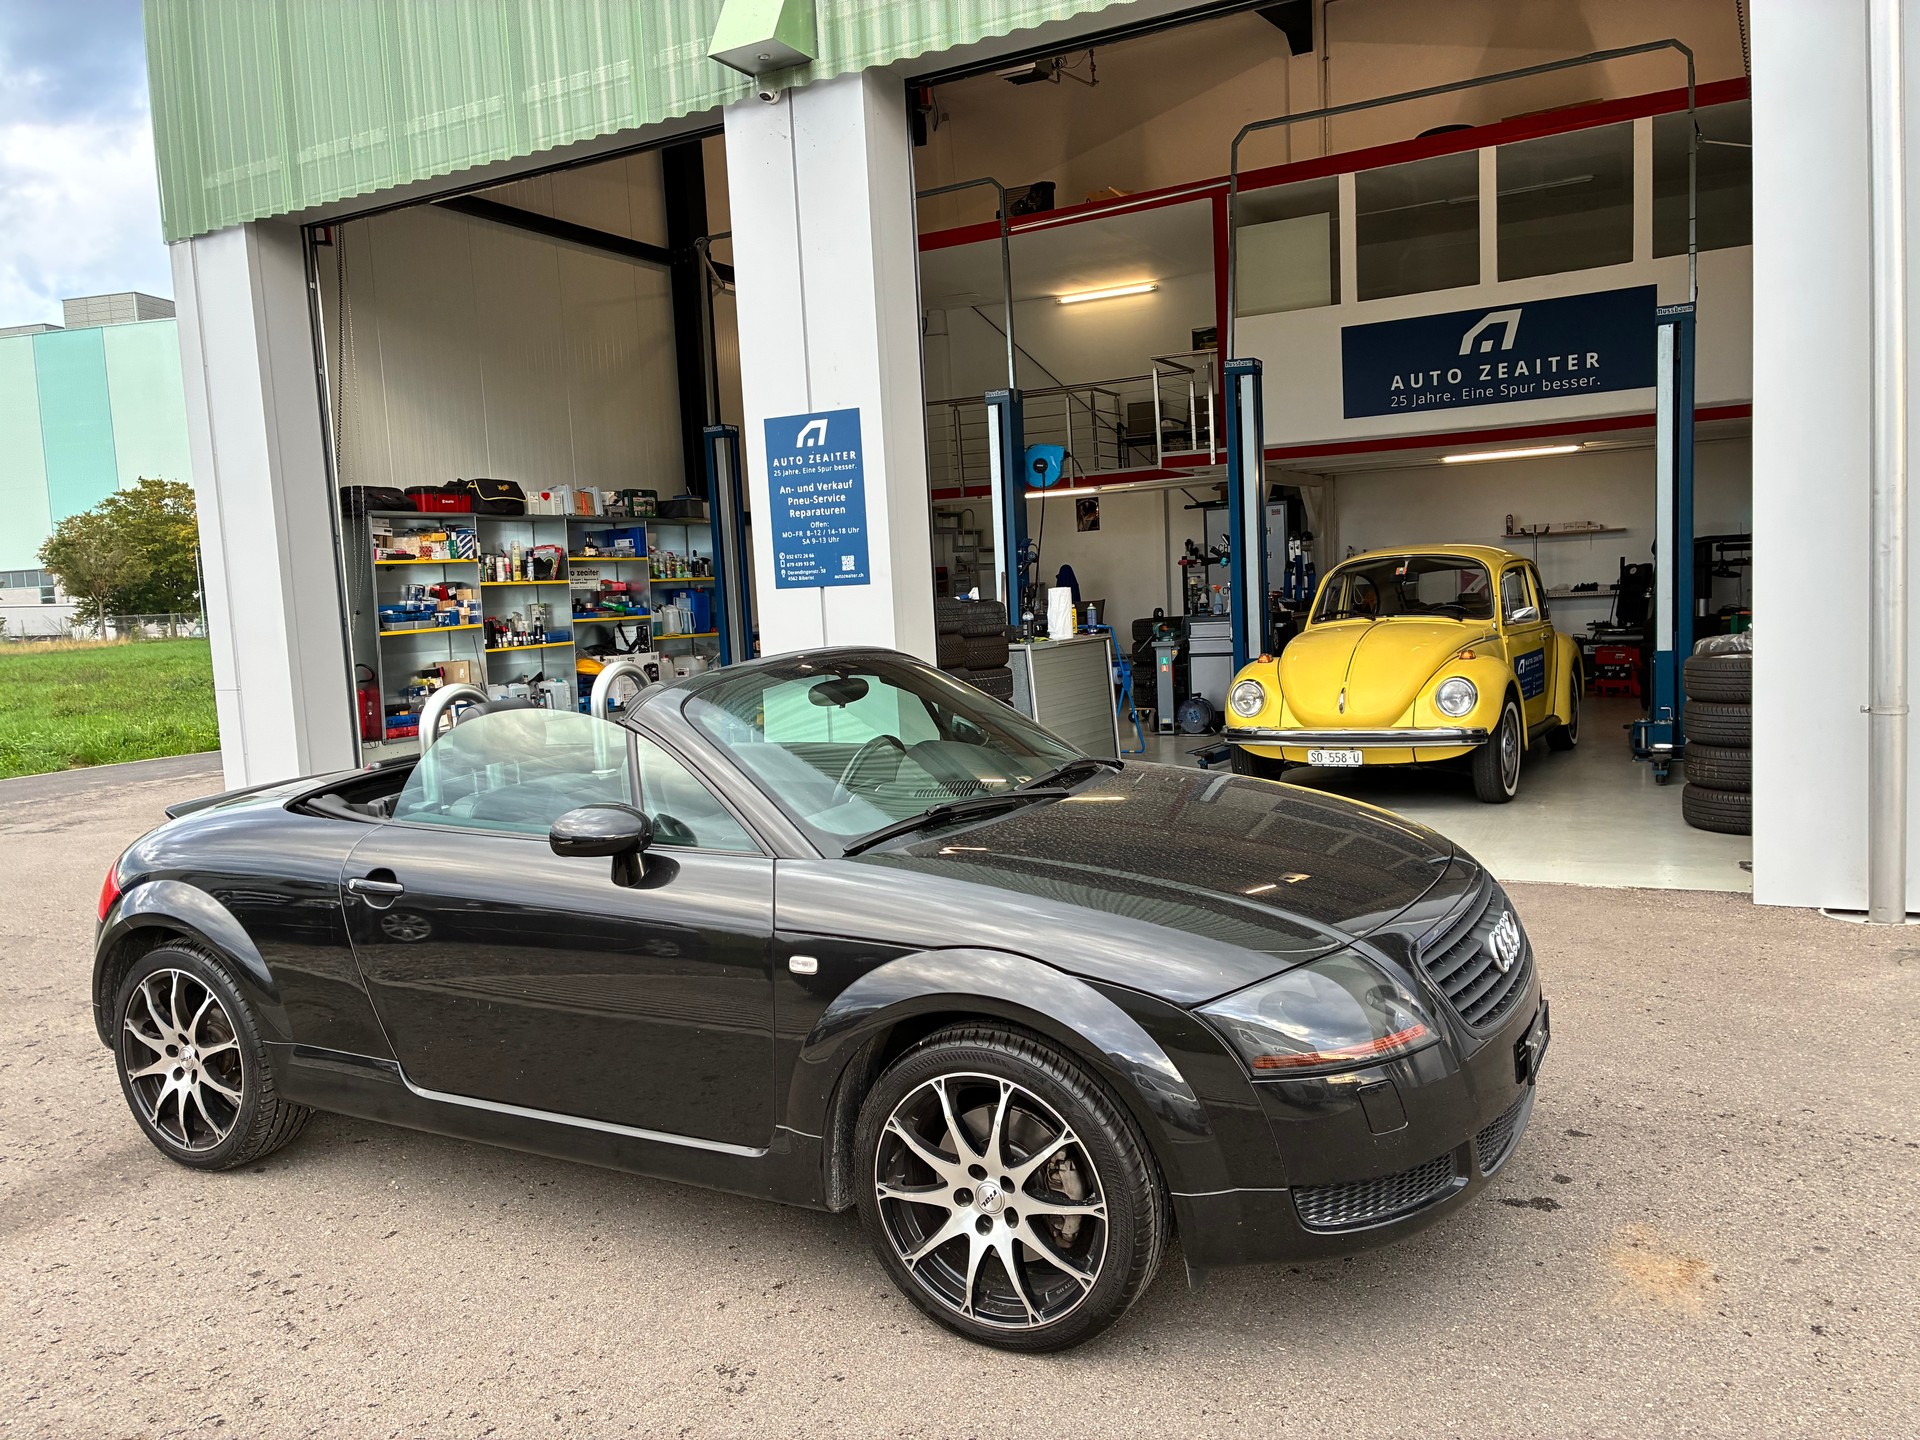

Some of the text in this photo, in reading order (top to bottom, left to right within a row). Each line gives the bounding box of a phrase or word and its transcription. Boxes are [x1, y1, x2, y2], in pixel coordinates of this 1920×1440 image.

[1390, 352, 1600, 391] AUTO ZEAITER
[1390, 375, 1601, 407] 25 Jahre. Eine Spur besser.
[773, 450, 857, 467] AUTO ZEAITER
[773, 469, 781, 477] 25
[782, 468, 801, 477] Jahre.
[780, 479, 853, 494] An- und Verkauf
[787, 494, 846, 506] Pneu-Service
[789, 506, 846, 519] Reparaturen
[782, 530, 804, 538] MO-FR
[806, 529, 822, 537] 8-12
[1311, 752, 1360, 763] SO 558 U
